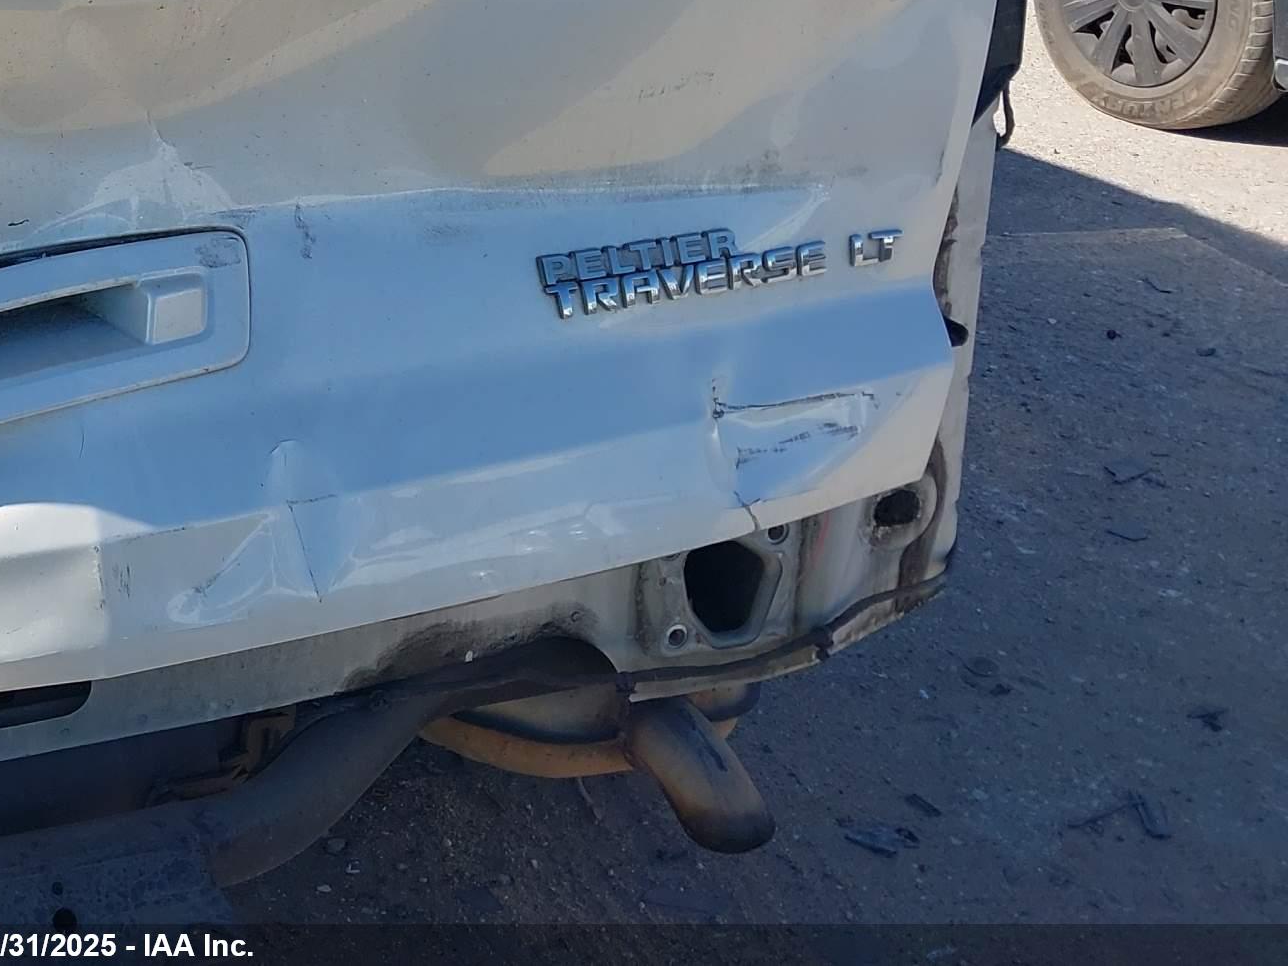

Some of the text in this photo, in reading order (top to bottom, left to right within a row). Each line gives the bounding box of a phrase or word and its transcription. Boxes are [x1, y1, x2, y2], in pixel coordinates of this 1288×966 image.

[536, 228, 740, 286] PELTIER
[546, 229, 903, 320] TRAVERSE LT
